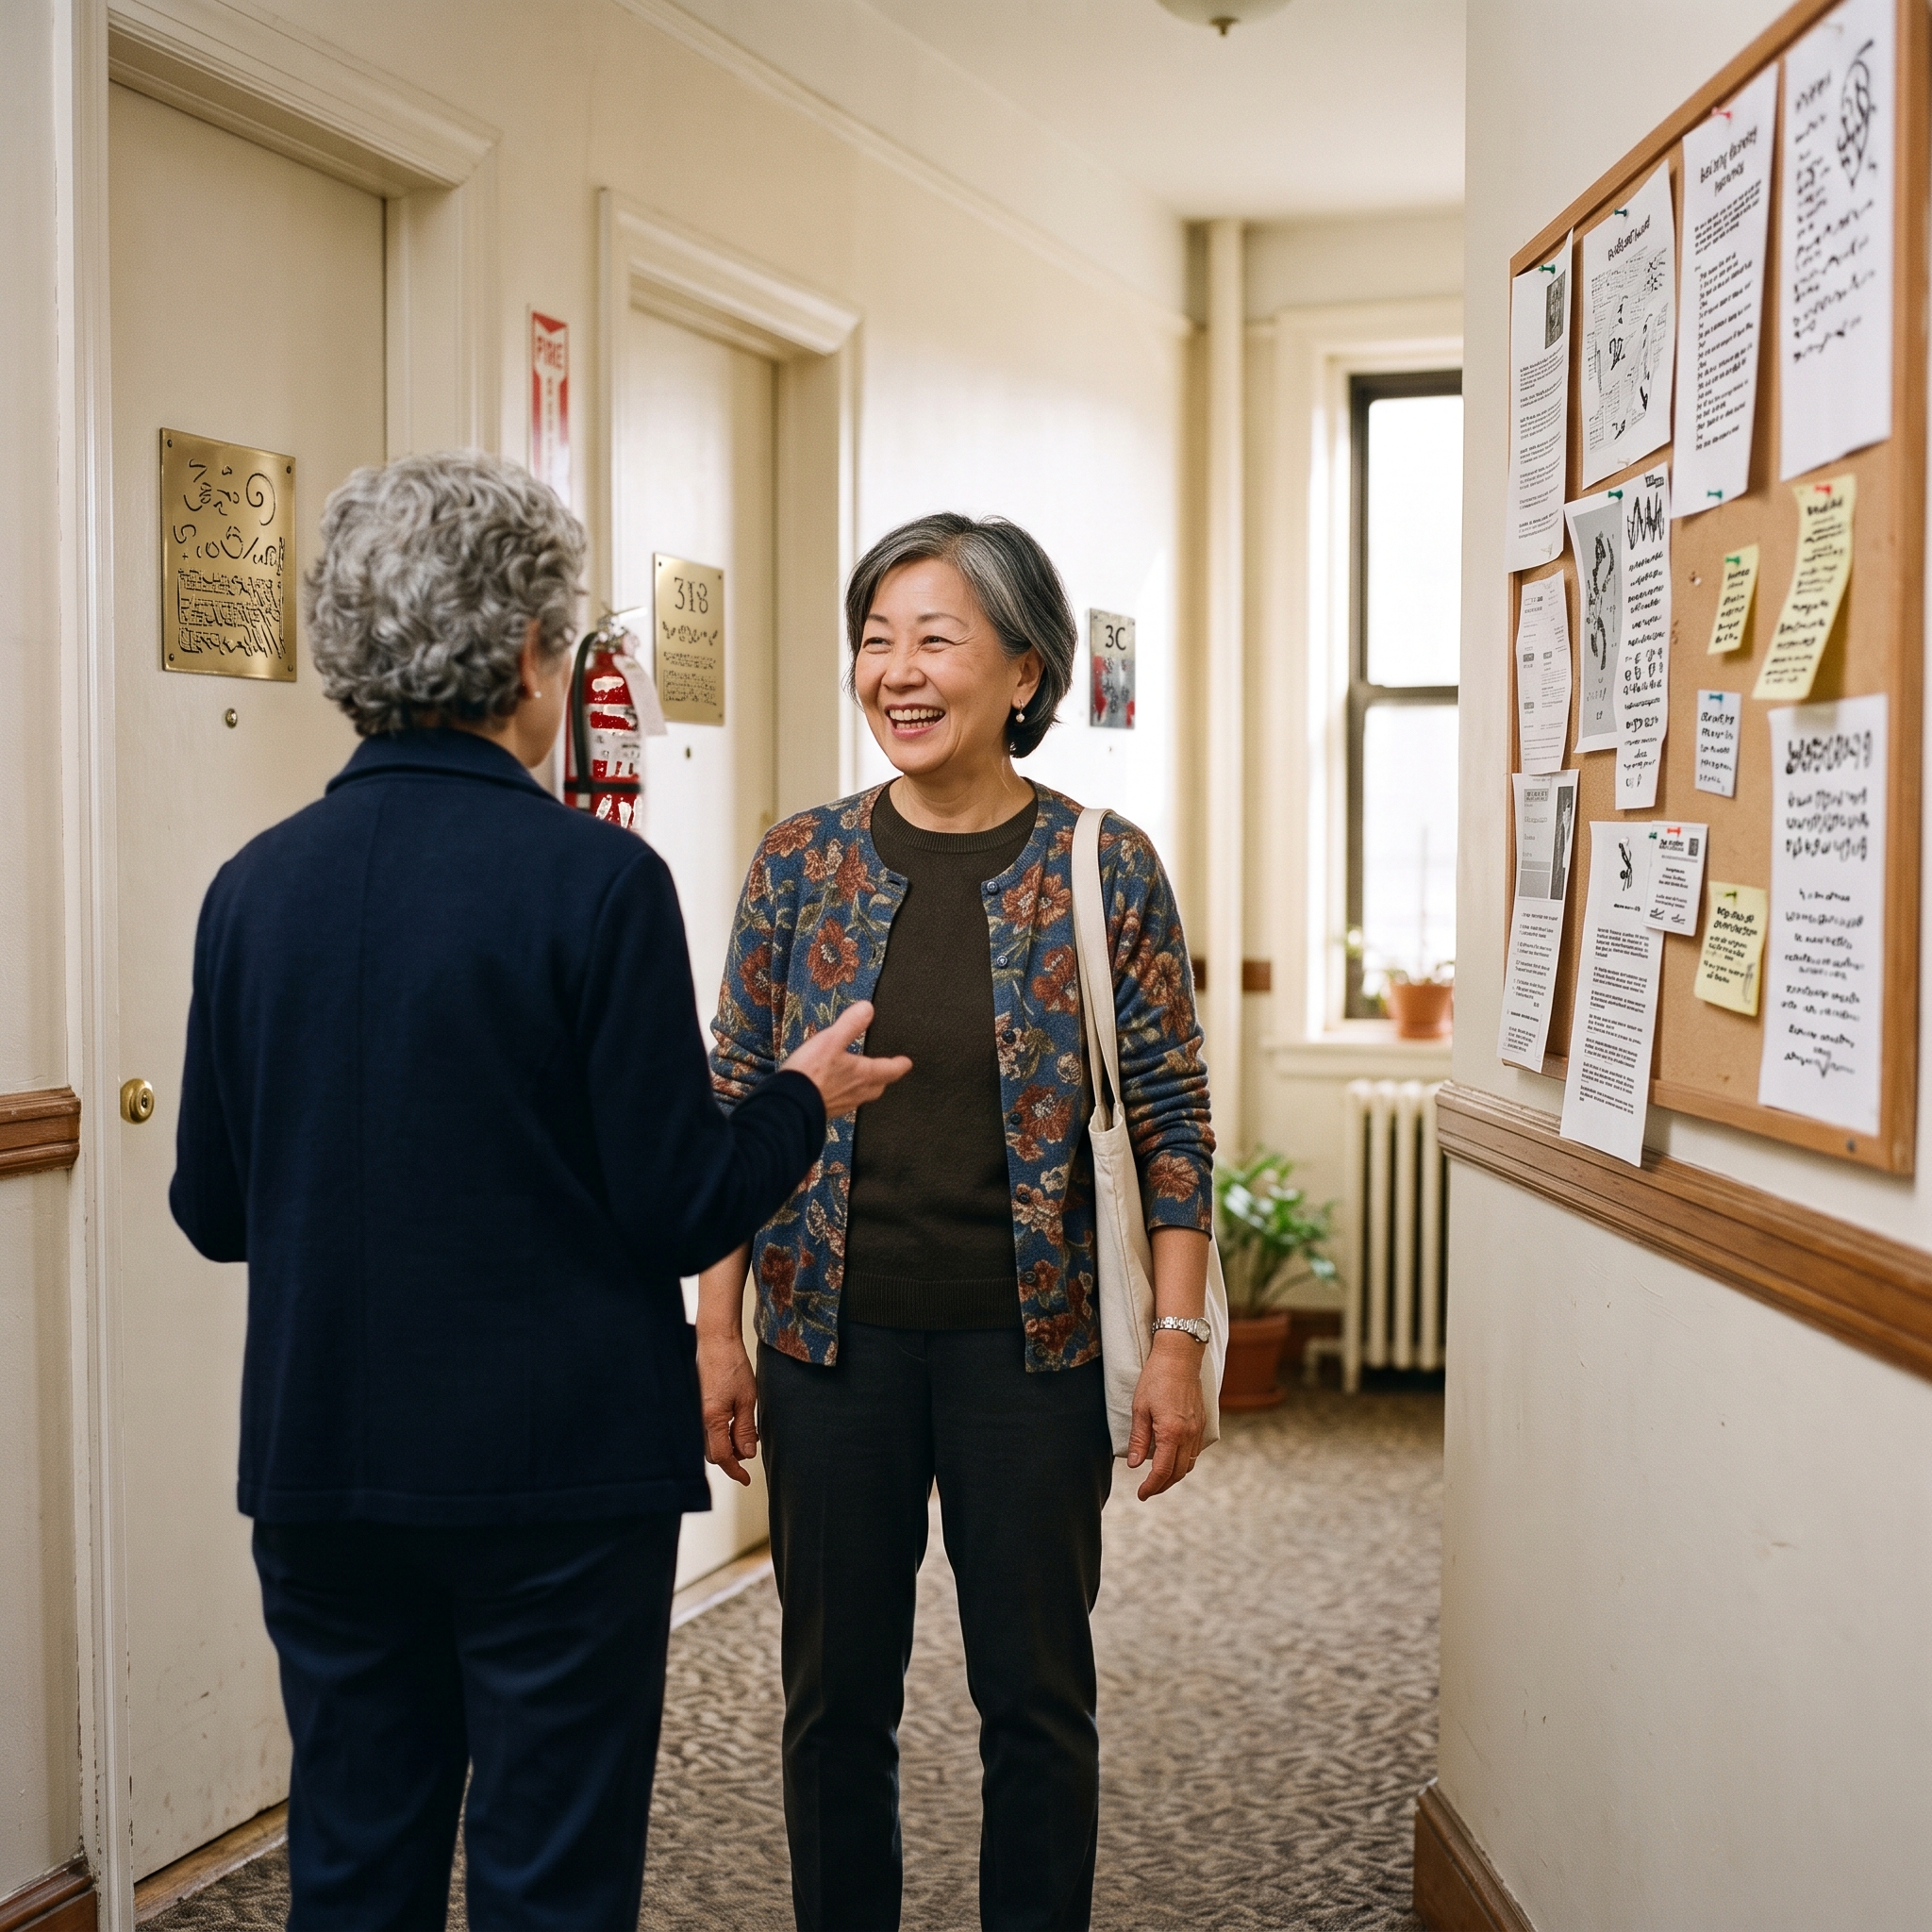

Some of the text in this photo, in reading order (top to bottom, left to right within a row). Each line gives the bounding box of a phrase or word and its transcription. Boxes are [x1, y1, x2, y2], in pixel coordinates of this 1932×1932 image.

[537, 335, 564, 370] FIRE
[675, 576, 708, 614] 318
[1105, 625, 1126, 651] 3C
